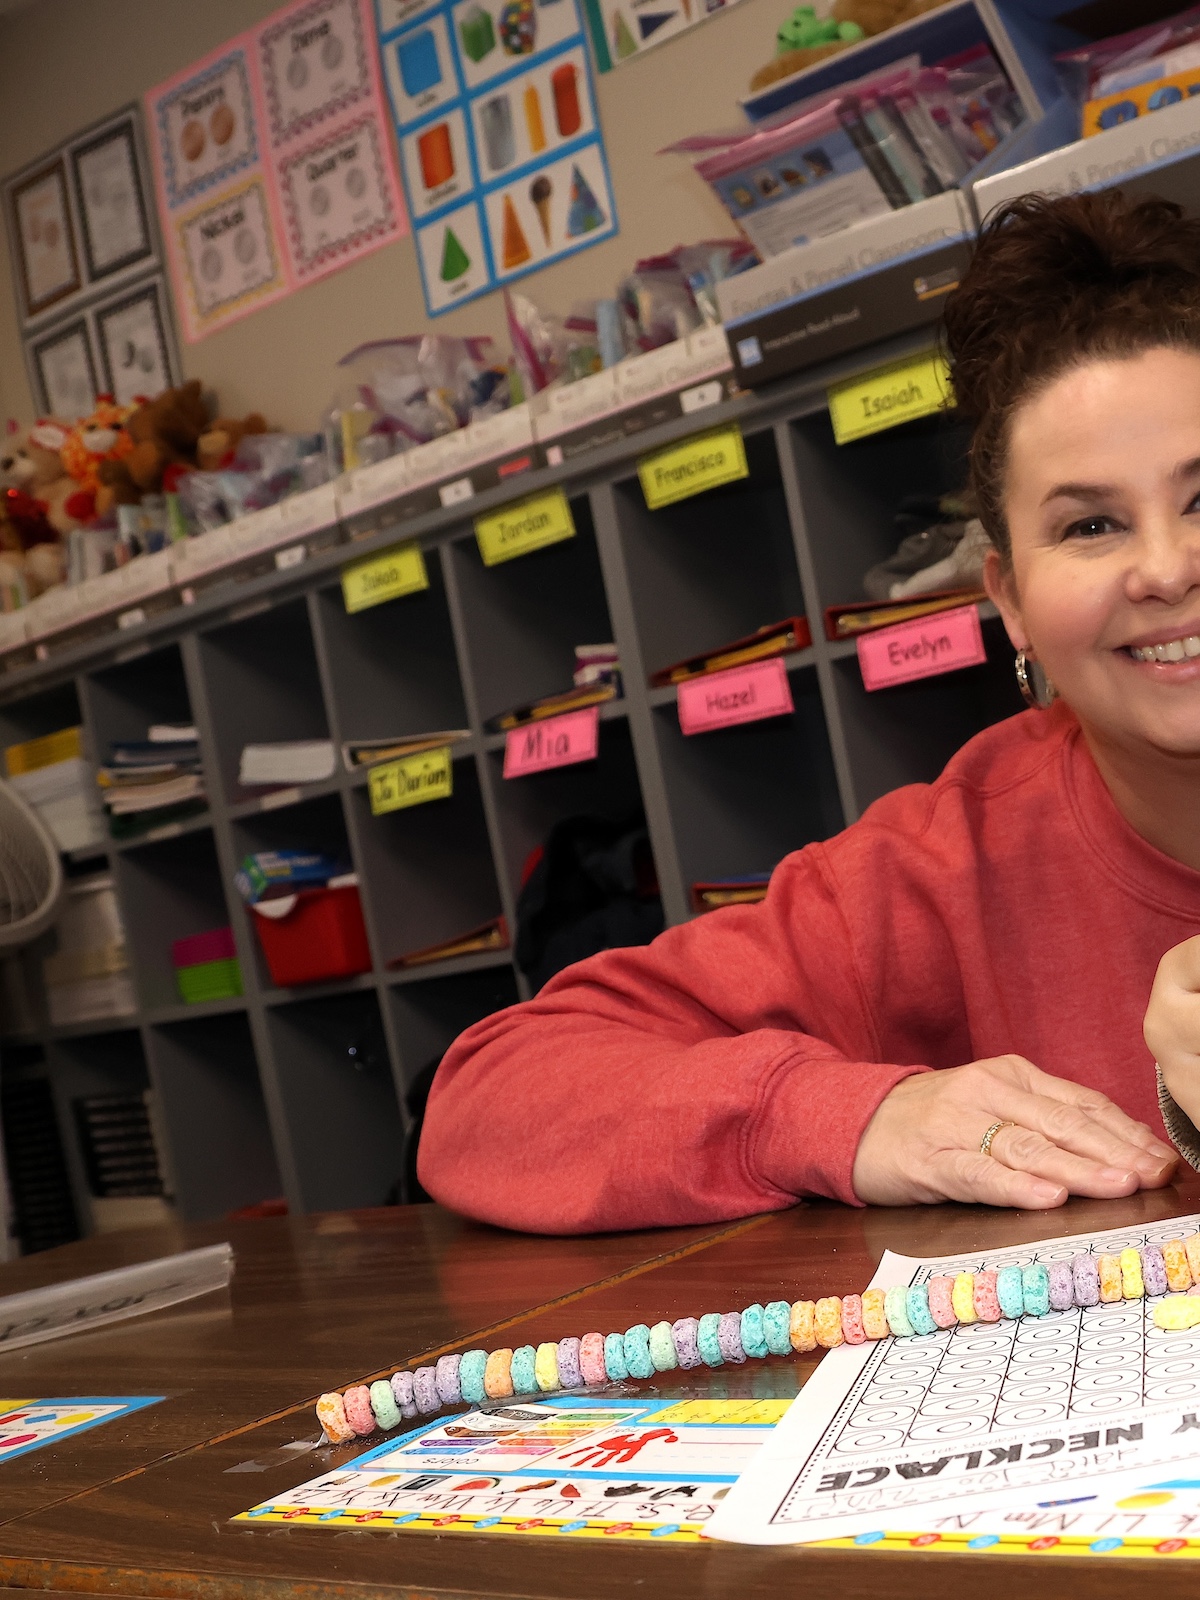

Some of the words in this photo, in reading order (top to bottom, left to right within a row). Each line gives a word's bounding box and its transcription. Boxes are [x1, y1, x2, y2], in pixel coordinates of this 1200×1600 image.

[859, 380, 923, 418] Isaiah
[654, 451, 726, 489] Francisco
[888, 637, 952, 667] Evelyn
[706, 683, 755, 713] Hazel
[522, 725, 570, 761] Mia
[421, 1457, 480, 1469] colors
[814, 1422, 1144, 1494] NECKLACE
[366, 1492, 416, 1508] Xx
[416, 1493, 475, 1511] Ww
[485, 1497, 520, 1513] Vv
[533, 1499, 574, 1515] Uu
[576, 1501, 619, 1518] Tt
[636, 1503, 674, 1519] Ss
[1003, 1513, 1083, 1531] Mm
[1095, 1514, 1147, 1533] Ll
